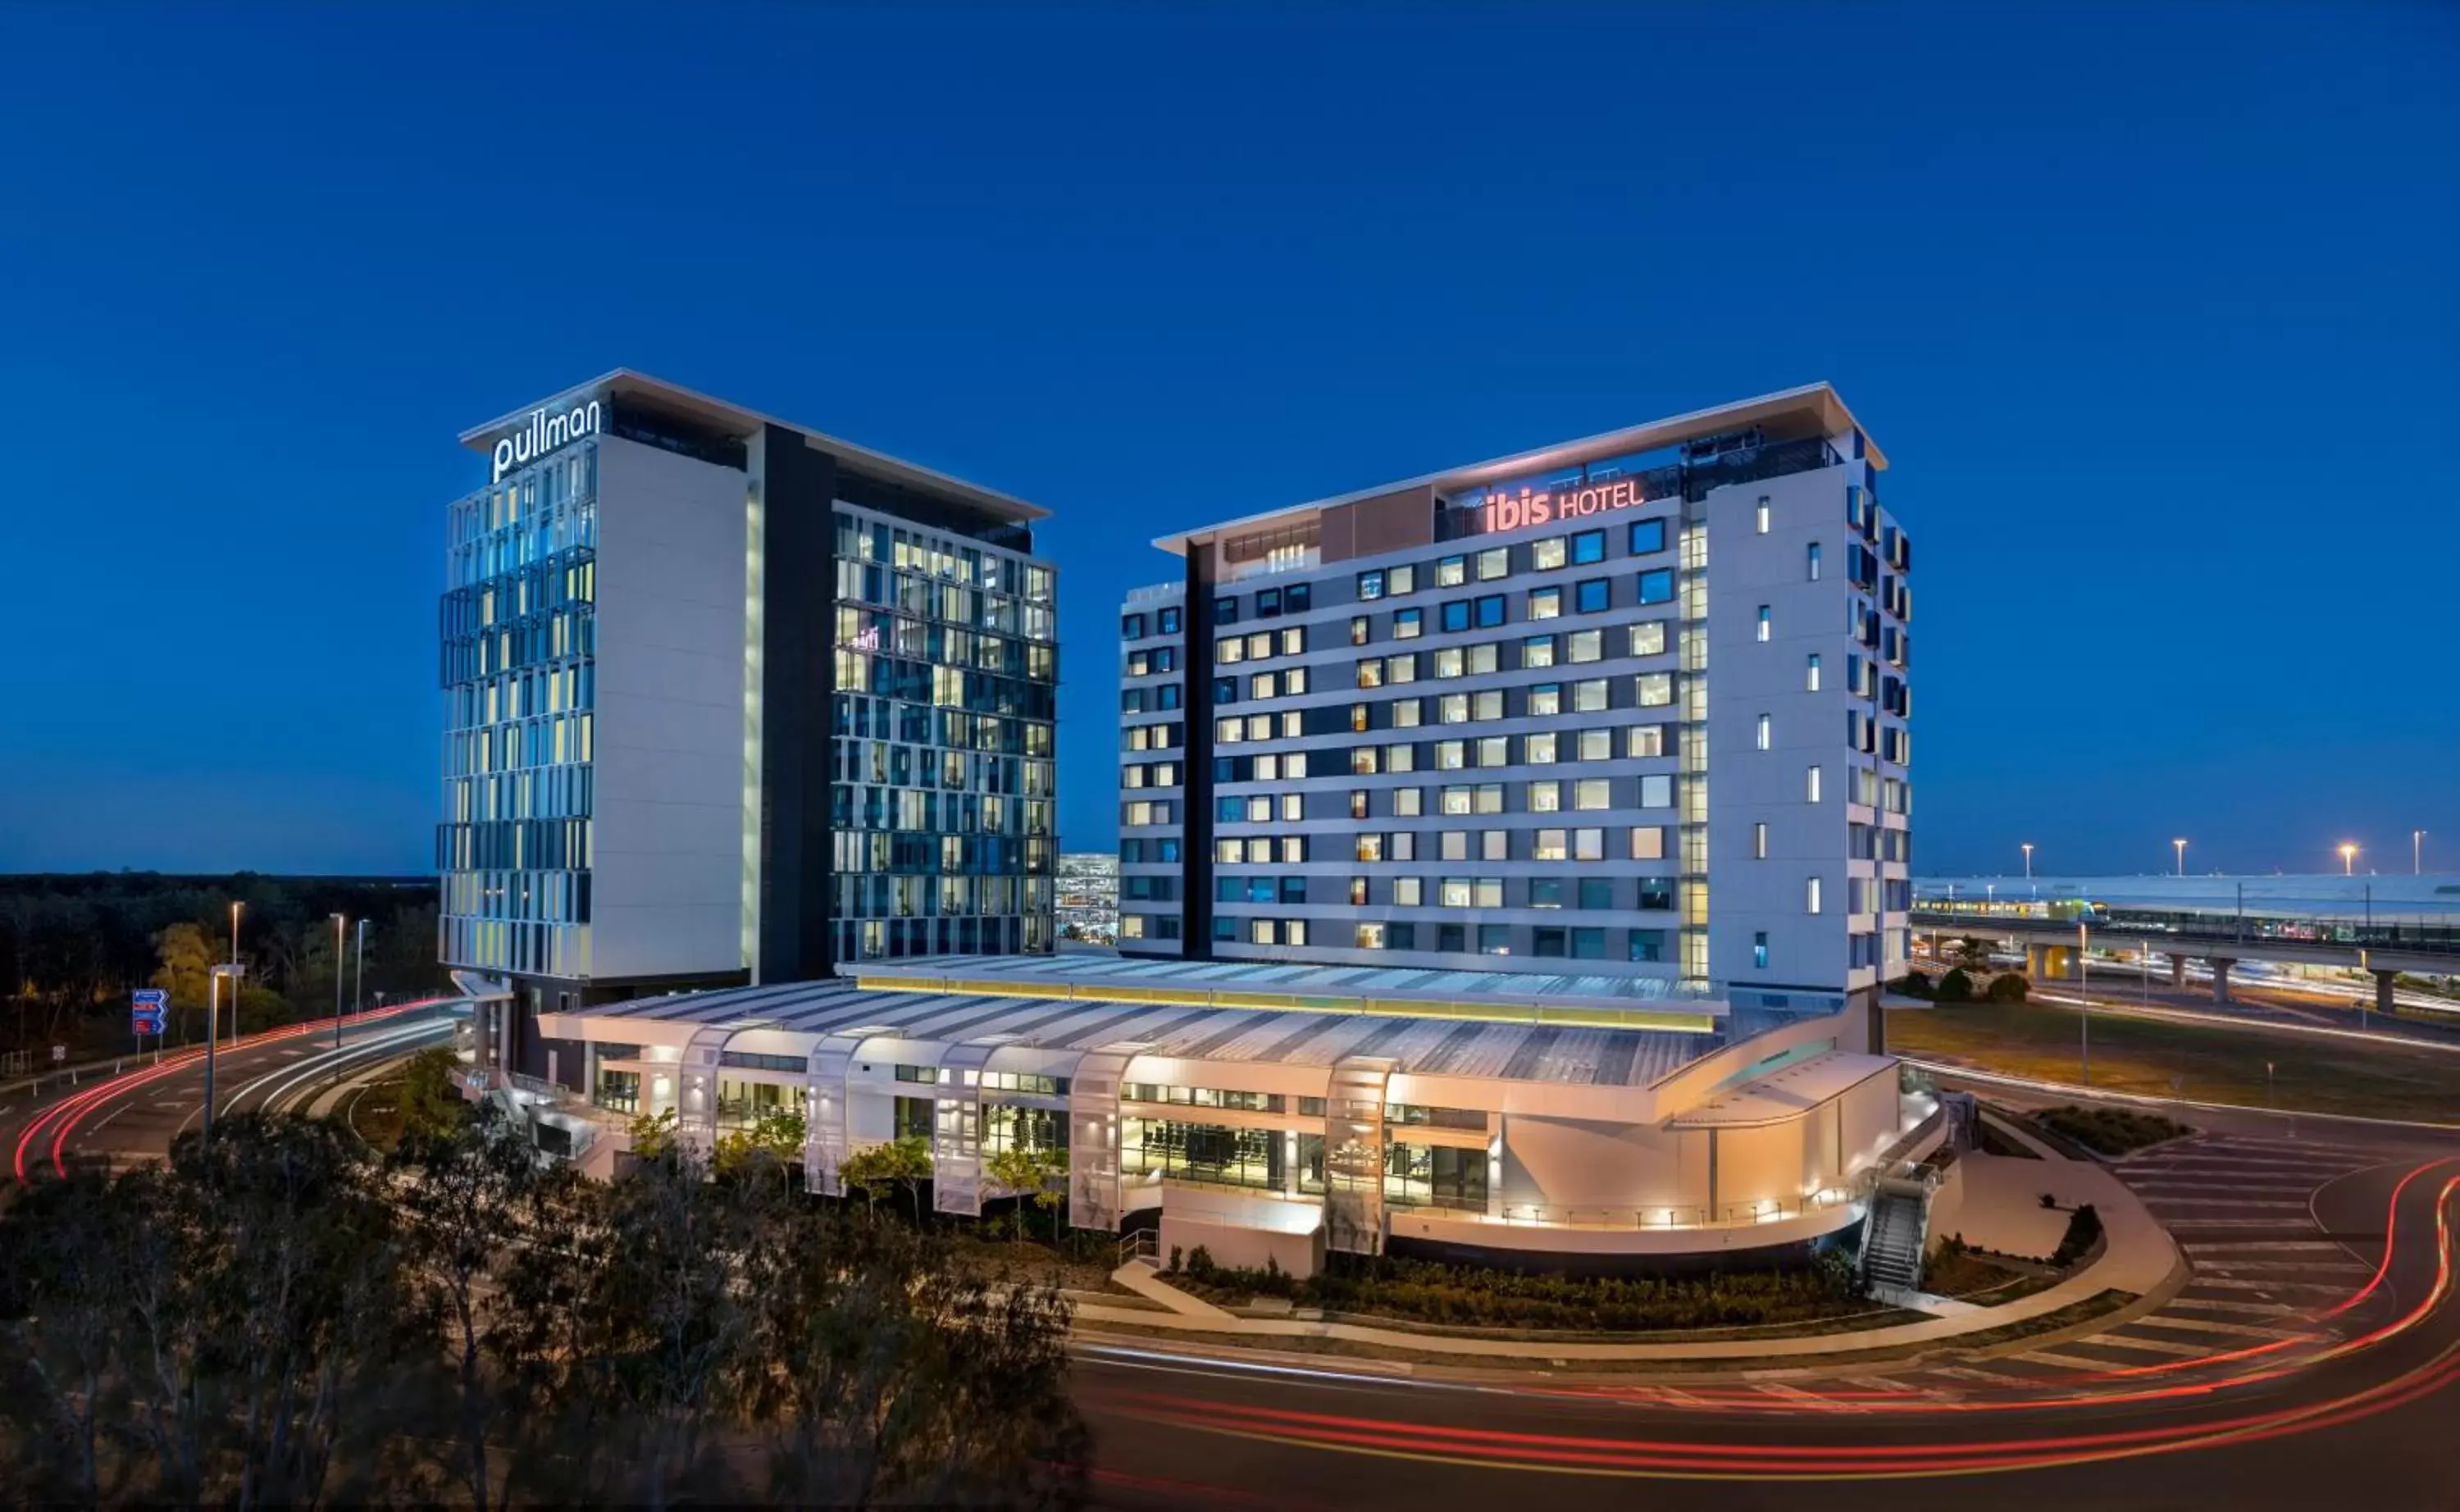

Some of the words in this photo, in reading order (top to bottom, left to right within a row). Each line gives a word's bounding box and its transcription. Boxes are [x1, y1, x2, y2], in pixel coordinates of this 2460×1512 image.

[494, 400, 600, 485] pullman
[1486, 488, 1551, 533] ibis
[1560, 480, 1644, 519] HOTEL
